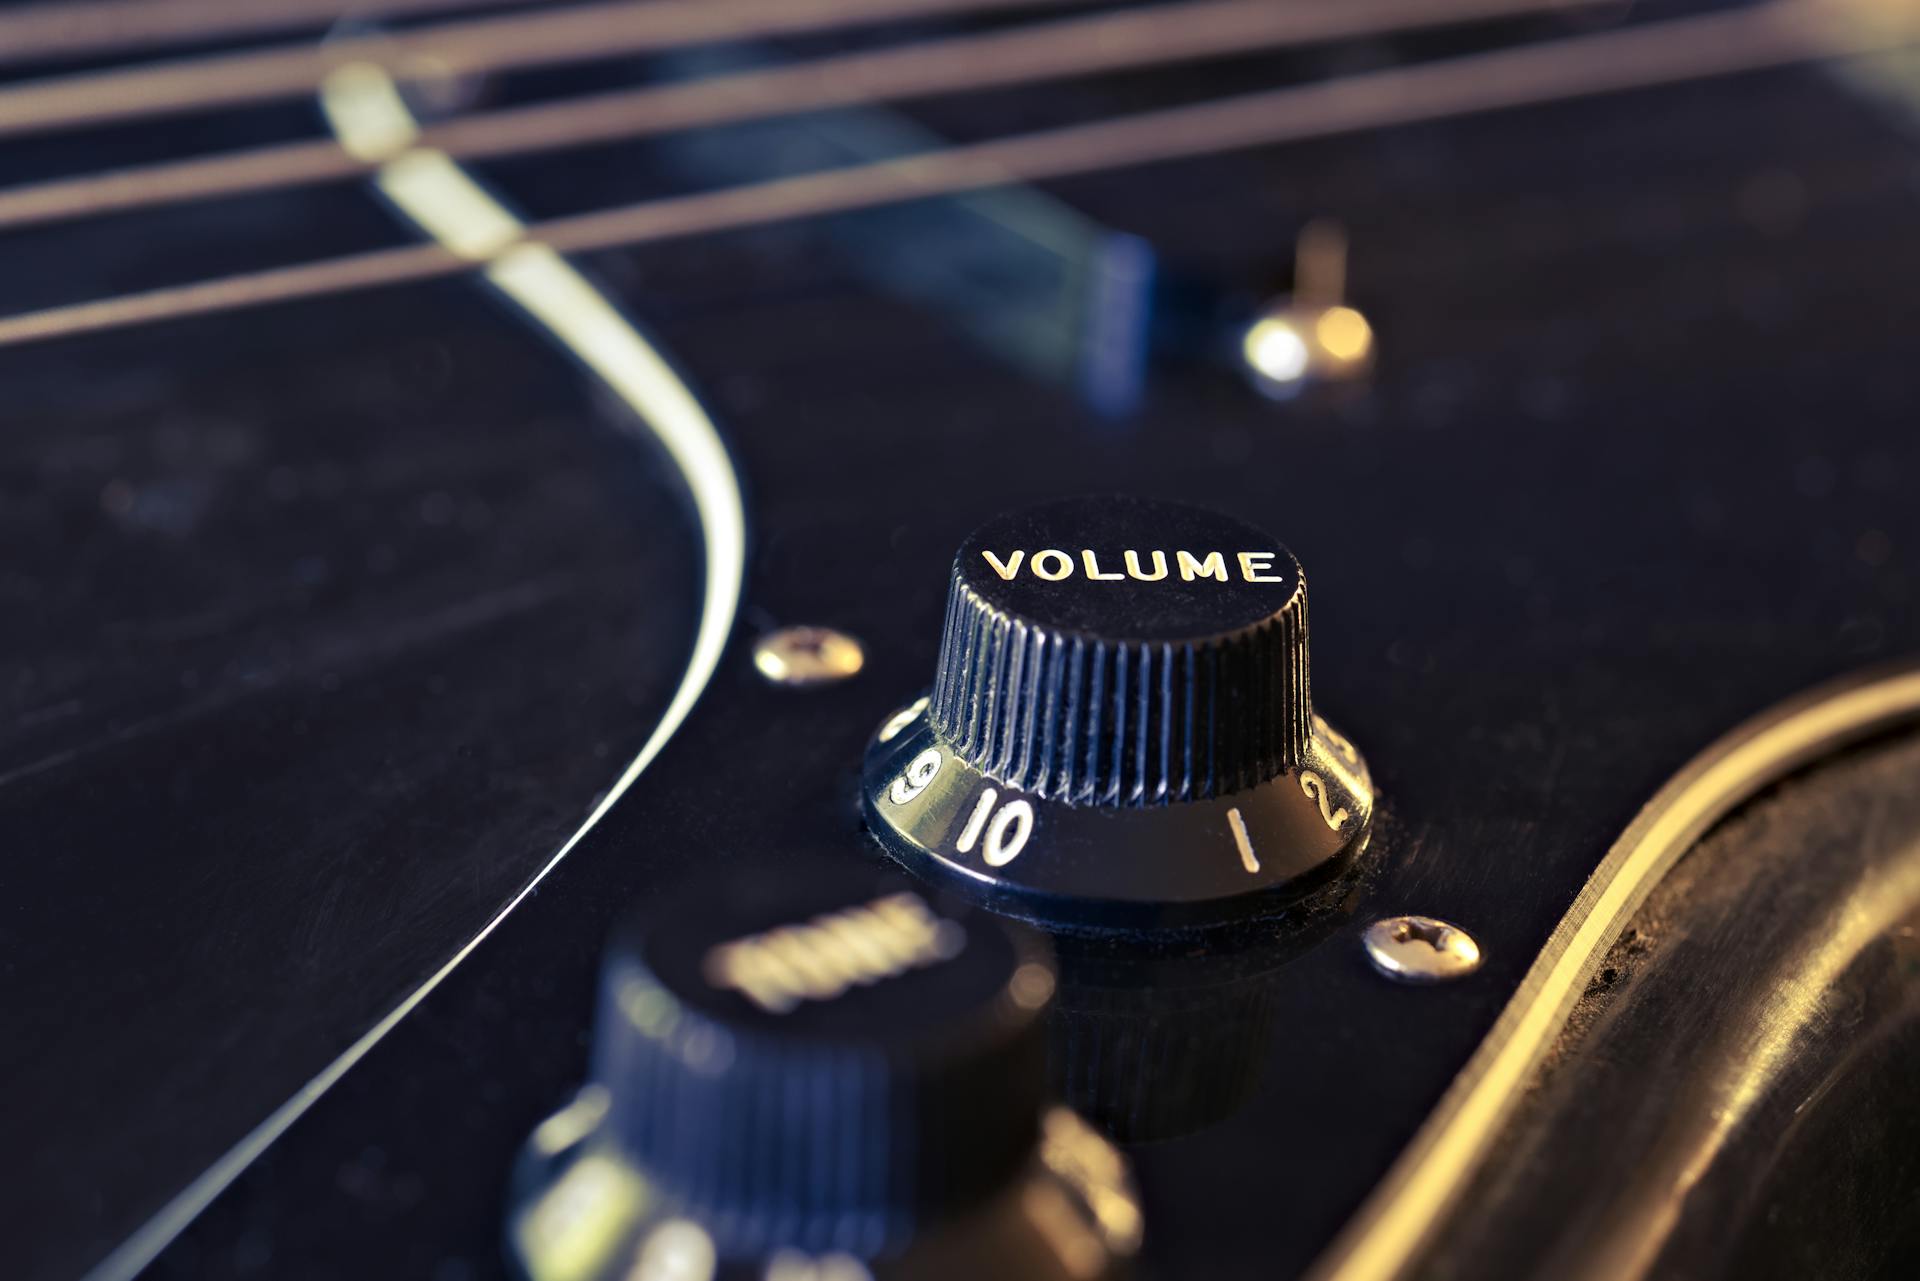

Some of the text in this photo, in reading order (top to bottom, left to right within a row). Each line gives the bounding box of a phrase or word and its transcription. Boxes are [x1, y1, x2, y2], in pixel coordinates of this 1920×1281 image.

[981, 549, 1283, 583] VOLUME
[889, 749, 942, 805] 9
[1300, 770, 1348, 831] 2
[957, 788, 1033, 867] 10
[1227, 808, 1260, 874] 1
